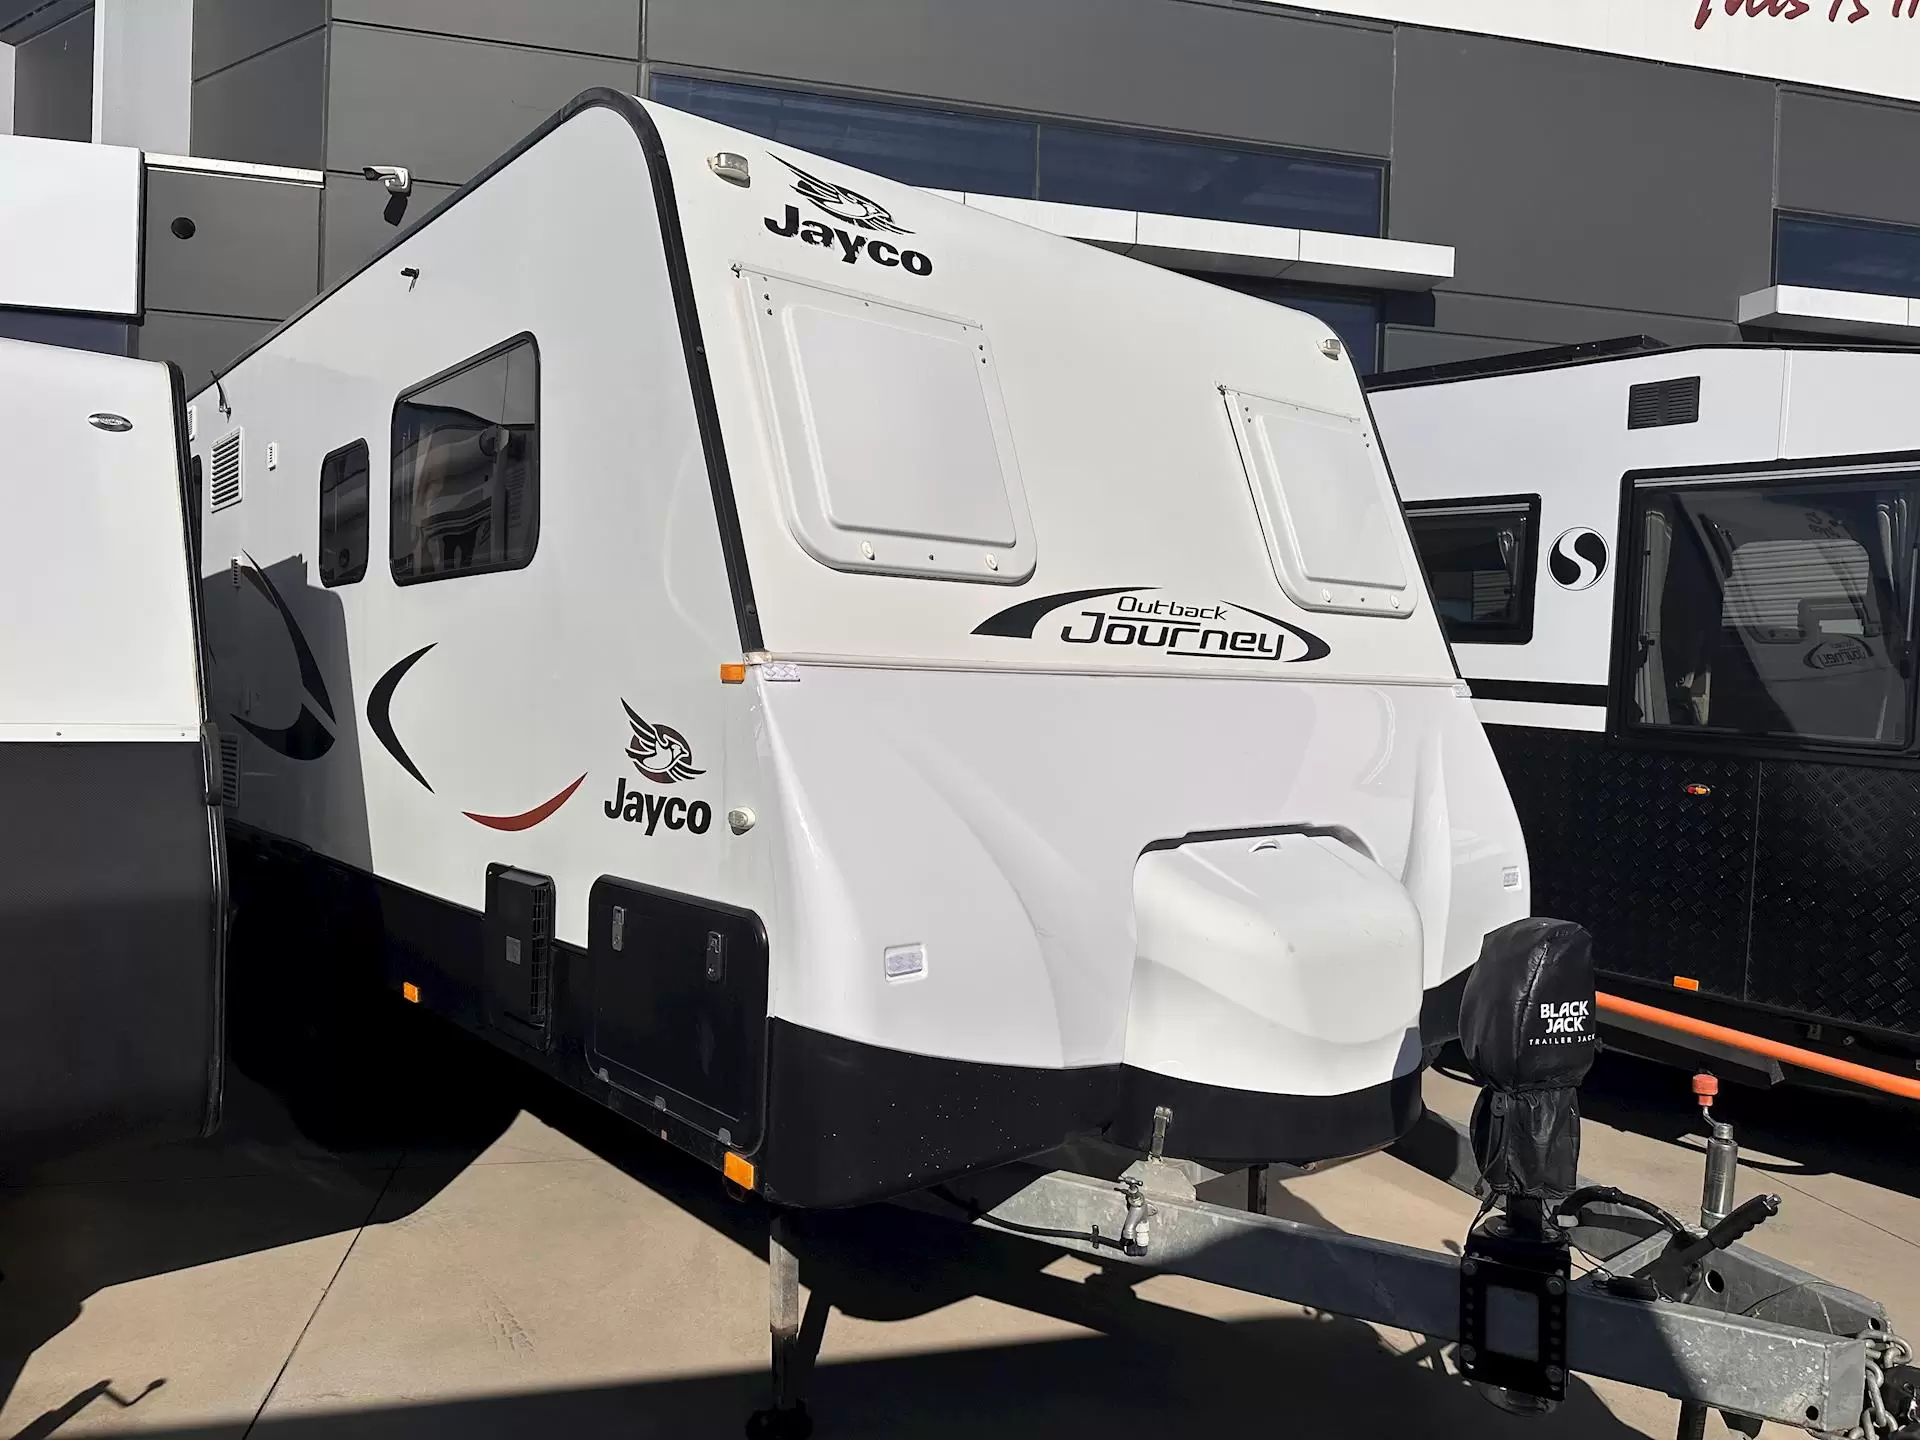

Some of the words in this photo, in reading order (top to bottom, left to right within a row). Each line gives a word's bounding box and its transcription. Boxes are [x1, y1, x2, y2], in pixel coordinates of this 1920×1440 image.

[763, 204, 933, 276] Jayco
[1117, 595, 1229, 621] Outback
[1060, 611, 1285, 661] Journey
[604, 777, 712, 836] Jayco
[1540, 1000, 1589, 1019] BLACK
[1545, 1016, 1585, 1034] JACK
[1529, 1036, 1573, 1046] TRAILER
[1577, 1033, 1596, 1043] JACK
